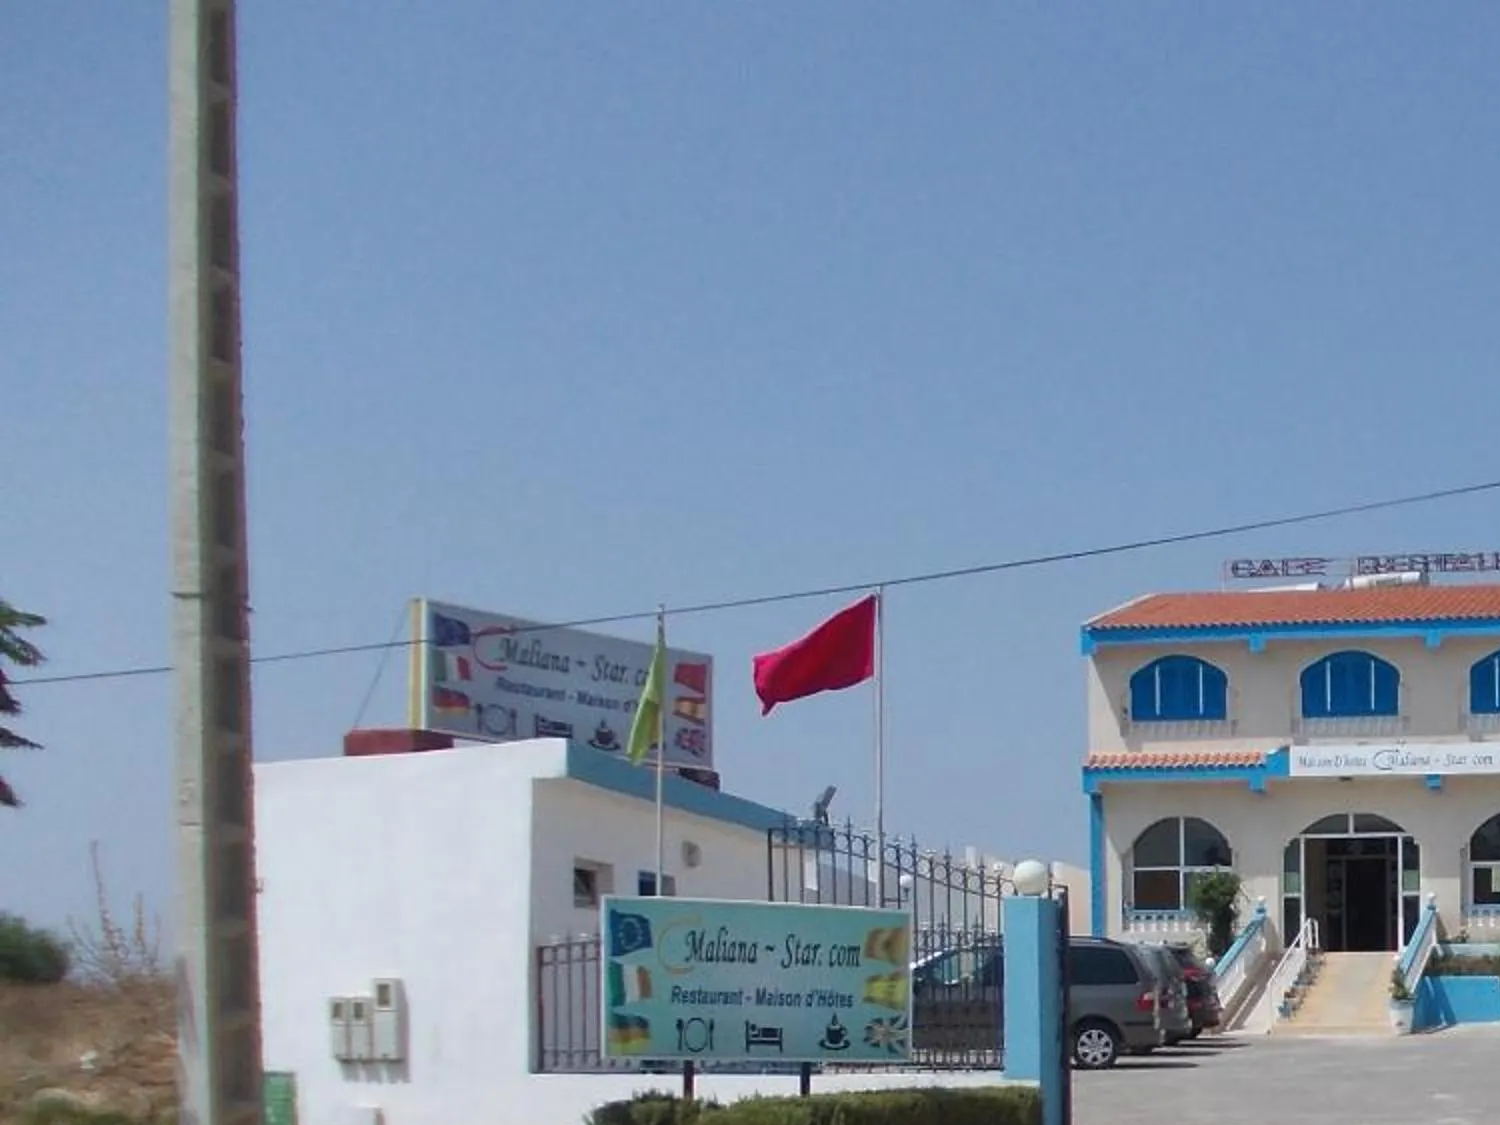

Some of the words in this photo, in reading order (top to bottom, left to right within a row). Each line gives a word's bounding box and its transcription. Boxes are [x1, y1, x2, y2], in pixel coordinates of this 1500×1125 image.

[496, 637, 570, 674] Maliana
[495, 676, 567, 703] Restaurant
[684, 926, 758, 964] Maliana
[828, 943, 861, 968] com
[671, 985, 744, 1006] Restaurant
[755, 987, 801, 1007] Maison
[804, 989, 854, 1009] d'Hôtes
